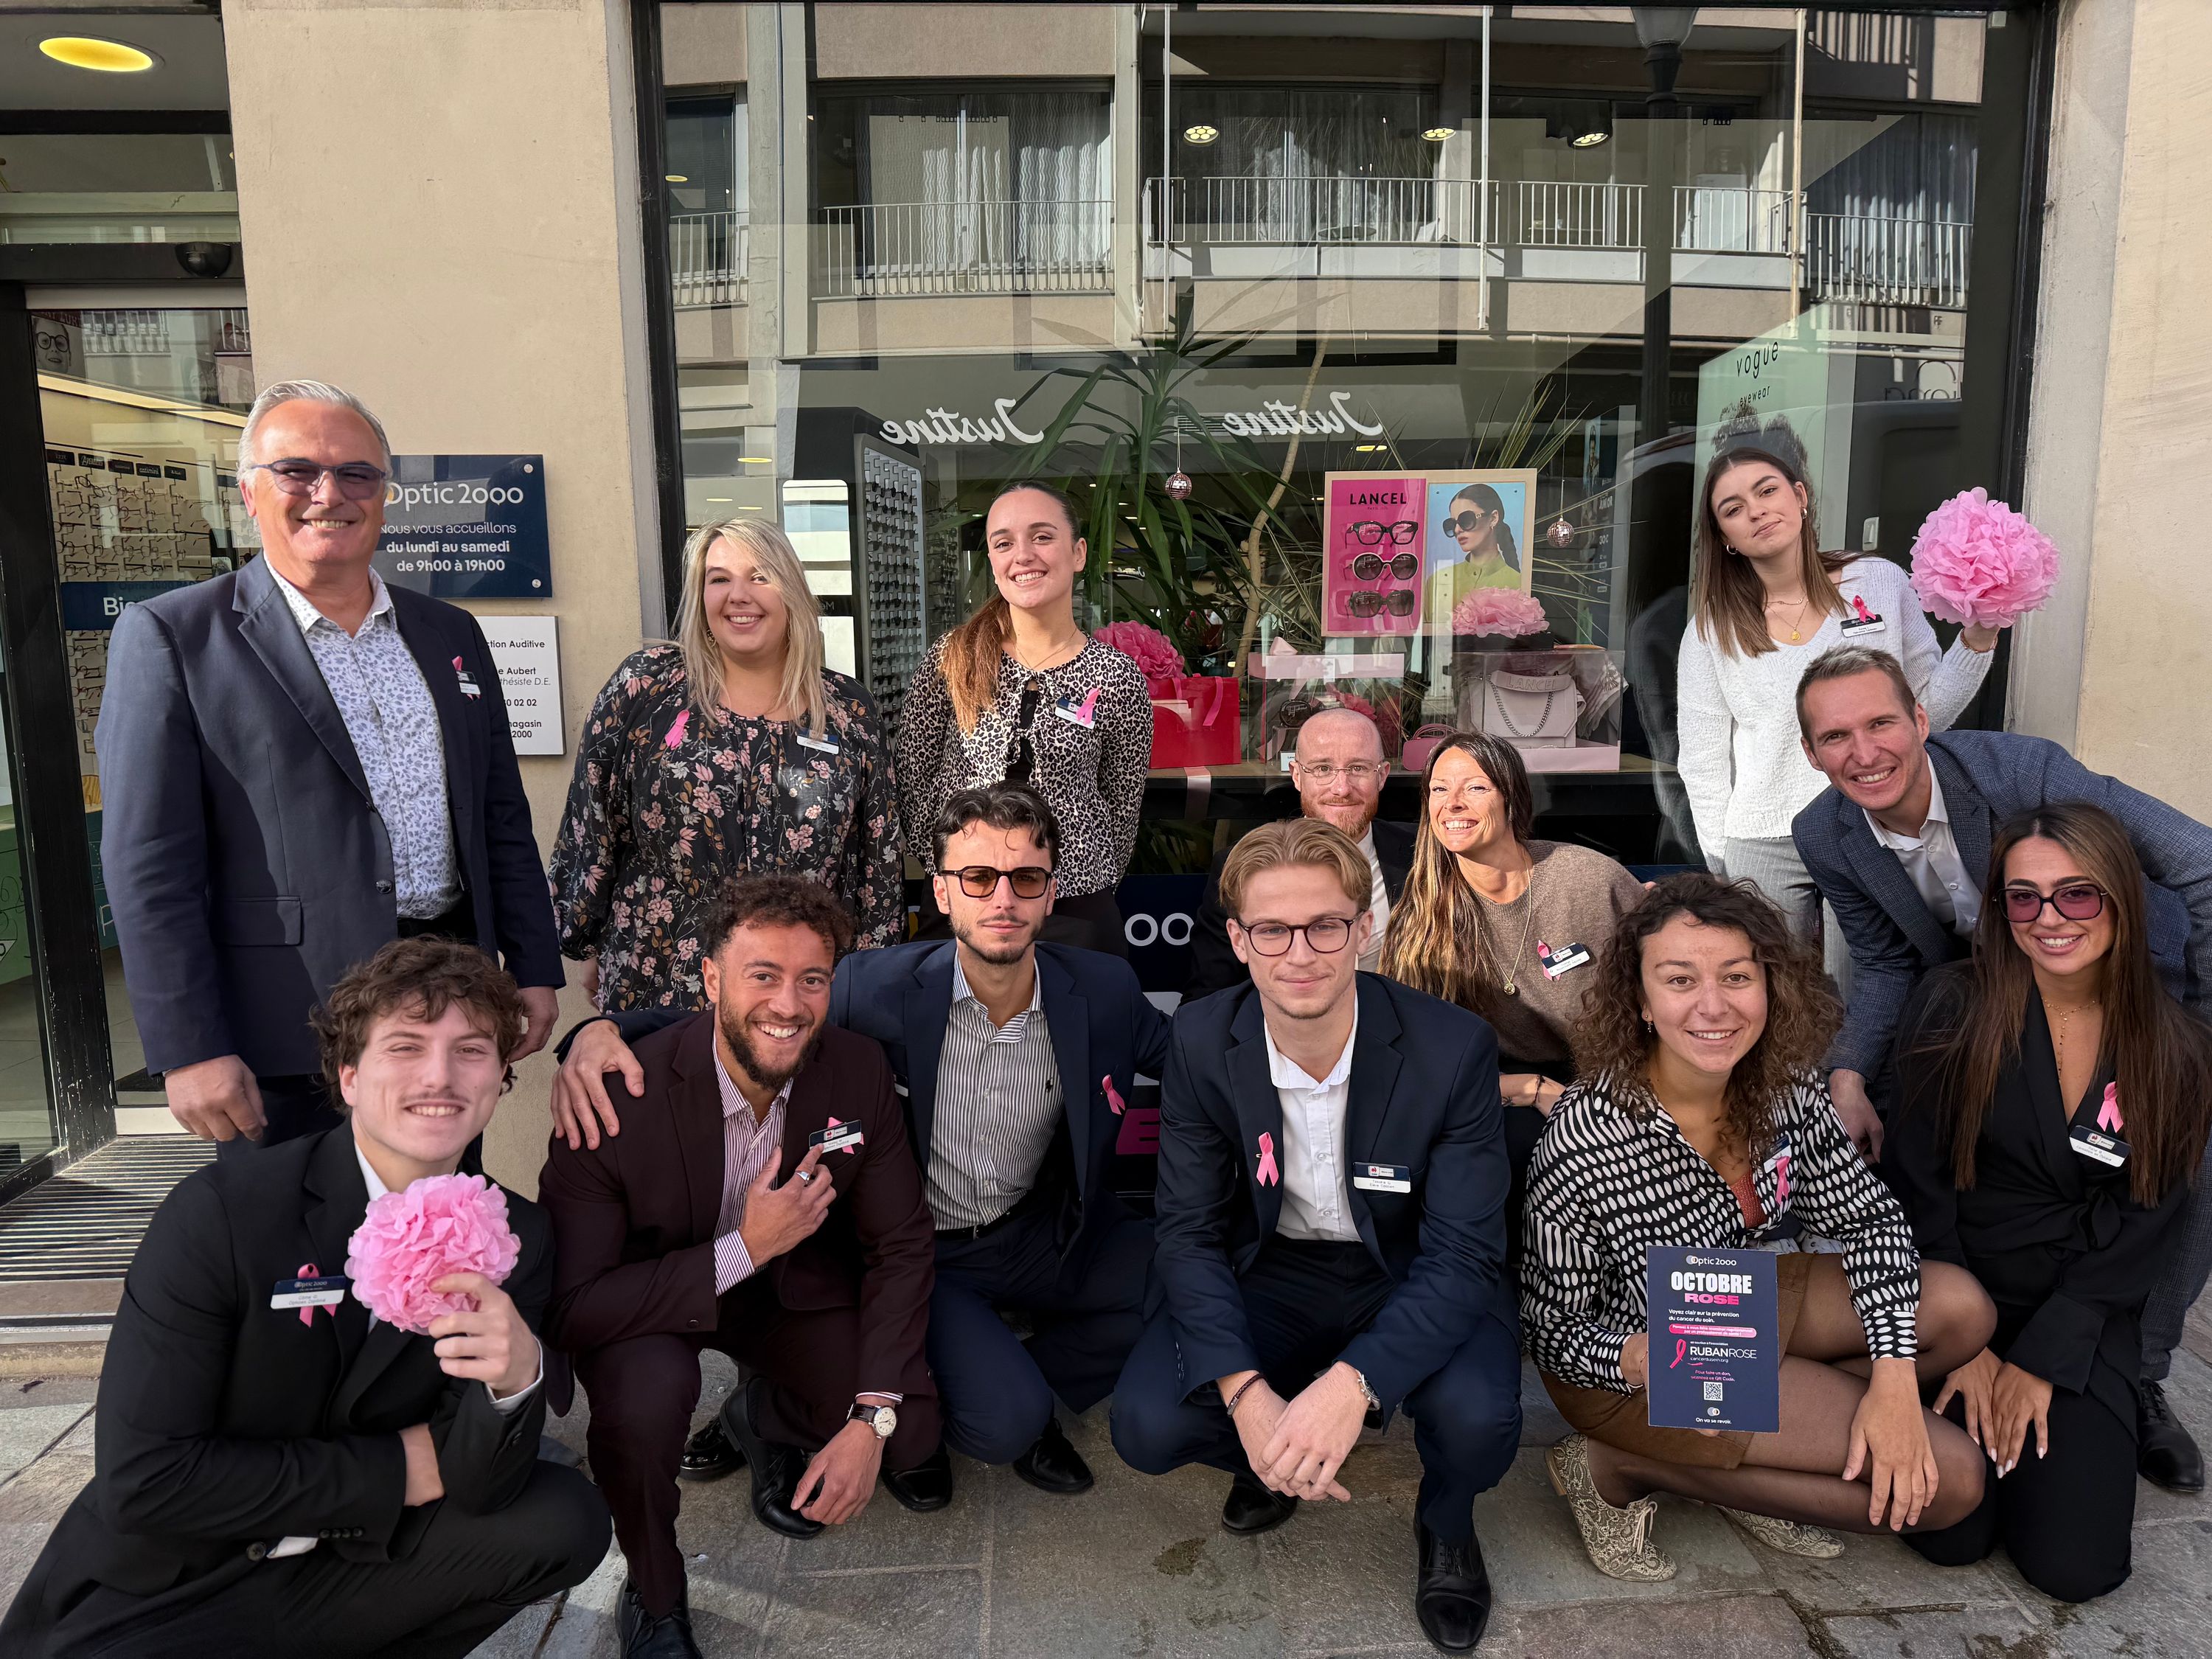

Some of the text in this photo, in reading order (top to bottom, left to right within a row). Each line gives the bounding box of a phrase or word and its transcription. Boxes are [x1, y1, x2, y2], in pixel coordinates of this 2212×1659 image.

[1736, 341, 1778, 379] vogue
[1740, 386, 1770, 407] eyewear
[387, 481, 524, 511] Optic 2000
[1349, 493, 1408, 505] LANCEL
[380, 522, 517, 534] Nous vous accueillons
[386, 540, 511, 553] du lundi au samedi
[396, 559, 506, 571] de 9h00 à 19h00
[509, 640, 546, 648] Auditive
[507, 667, 537, 675] Aubert
[500, 677, 552, 686] thésiste D.E.
[1506, 675, 1557, 691] LANCEL
[1689, 1255, 1737, 1267] Optic 2000
[1671, 1271, 1753, 1294] OCTOBRE
[1684, 1293, 1739, 1305] ROSE
[1690, 1346, 1757, 1359] RUBANROSE
